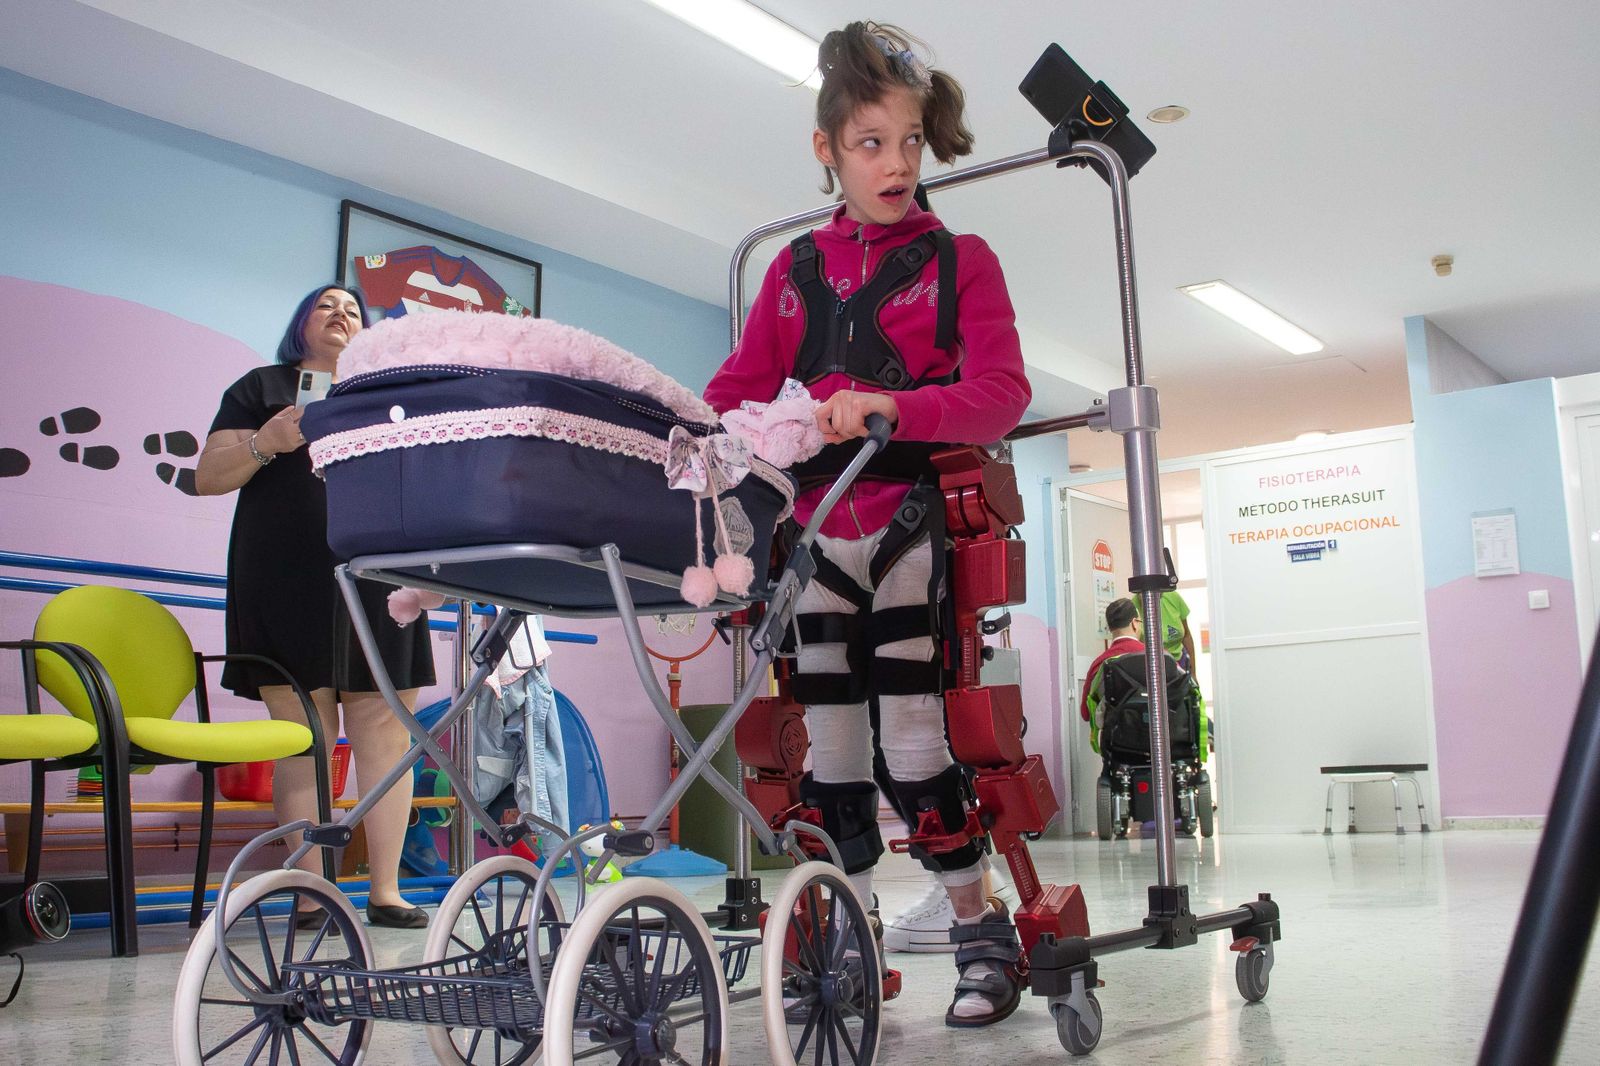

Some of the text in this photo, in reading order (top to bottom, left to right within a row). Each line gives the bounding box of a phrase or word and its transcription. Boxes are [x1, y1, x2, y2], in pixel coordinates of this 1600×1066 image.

[1259, 465, 1361, 488] FISIOTERAPIA
[1302, 489, 1386, 510] THERASUIT
[1229, 515, 1401, 545] TERAPIA OCUPACIONAL
[1095, 552, 1111, 569] STOP
